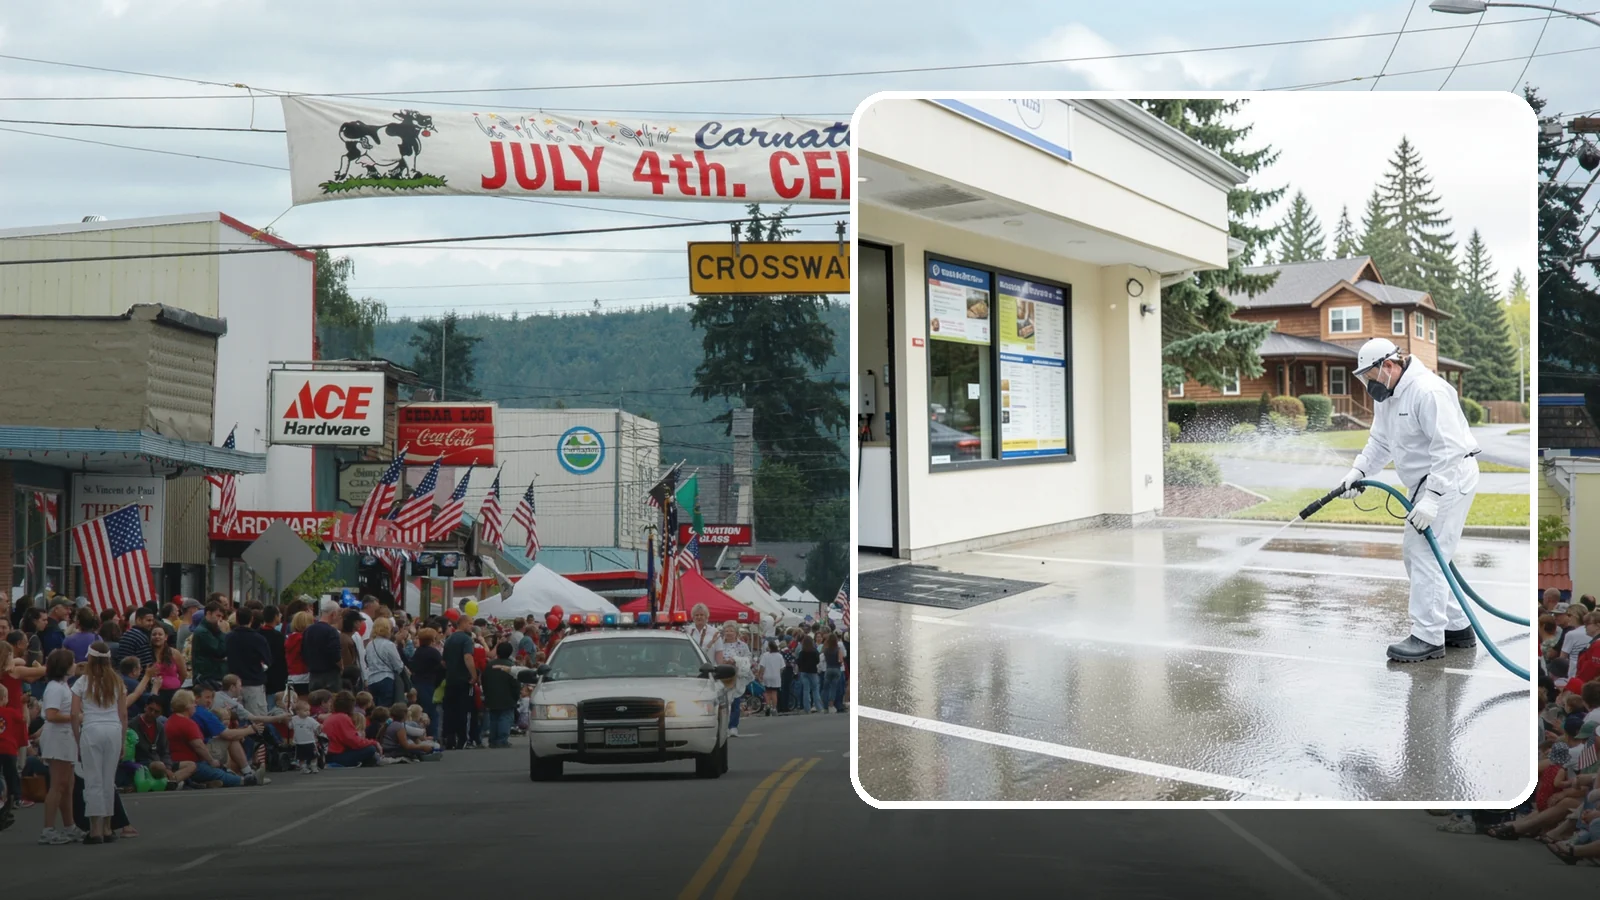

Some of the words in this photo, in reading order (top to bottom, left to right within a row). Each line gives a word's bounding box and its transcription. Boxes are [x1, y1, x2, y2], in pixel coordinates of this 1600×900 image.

[695, 121, 850, 149] Carnat
[481, 141, 605, 192] JULY
[632, 150, 746, 198] 4th.
[697, 254, 850, 279] CROSSWA
[283, 380, 373, 419] ACE
[405, 409, 452, 422] CEDAR
[461, 409, 486, 422] LOG
[283, 421, 371, 436] Hardware
[416, 428, 477, 446] Coca-Cola
[354, 467, 384, 479] Simpl
[83, 486, 93, 494] St.
[96, 485, 124, 494] Vincent
[126, 486, 135, 494] de
[137, 486, 155, 495] Paul
[81, 503, 153, 522] THRT
[212, 515, 330, 536] HARDARE
[688, 526, 741, 535] CRNATION
[699, 535, 730, 543] GLASS
